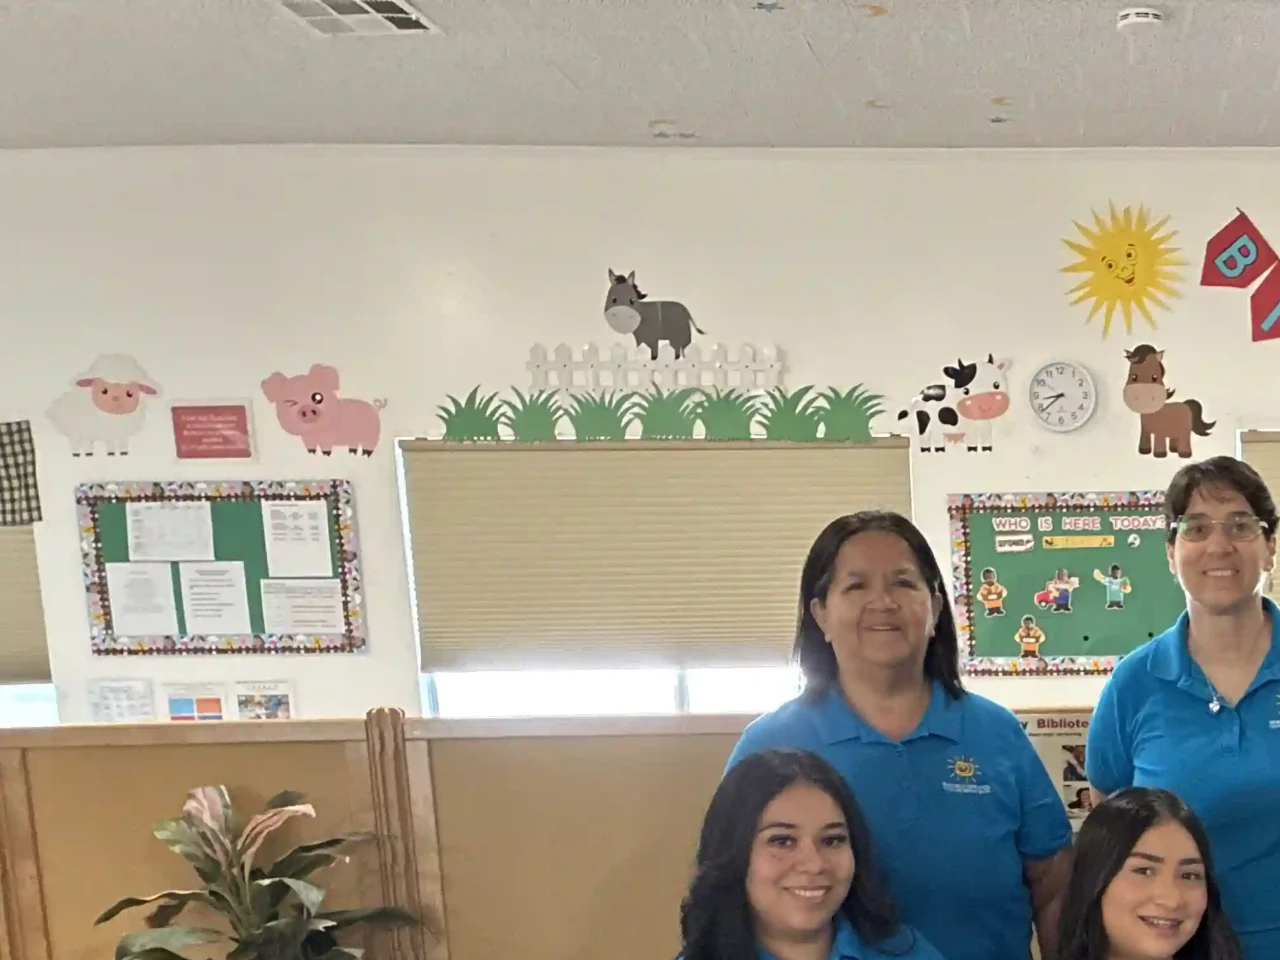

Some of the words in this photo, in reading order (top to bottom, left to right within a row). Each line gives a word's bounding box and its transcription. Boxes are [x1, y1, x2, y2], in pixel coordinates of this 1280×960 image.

[1045, 370, 1053, 379] 11
[1055, 366, 1065, 375] 12
[1035, 379, 1046, 387] 10
[1078, 378, 1084, 387] 2
[1033, 391, 1040, 400] 9
[1082, 391, 1088, 400] 3
[1077, 403, 1085, 411] 4
[1045, 411, 1052, 421] 7
[1058, 415, 1065, 425] 6
[1071, 411, 1077, 420] 5
[992, 516, 1030, 531] WHO
[1038, 516, 1053, 531] IS
[1062, 516, 1101, 530] HERE
[1036, 718, 1089, 729] Bibliote
